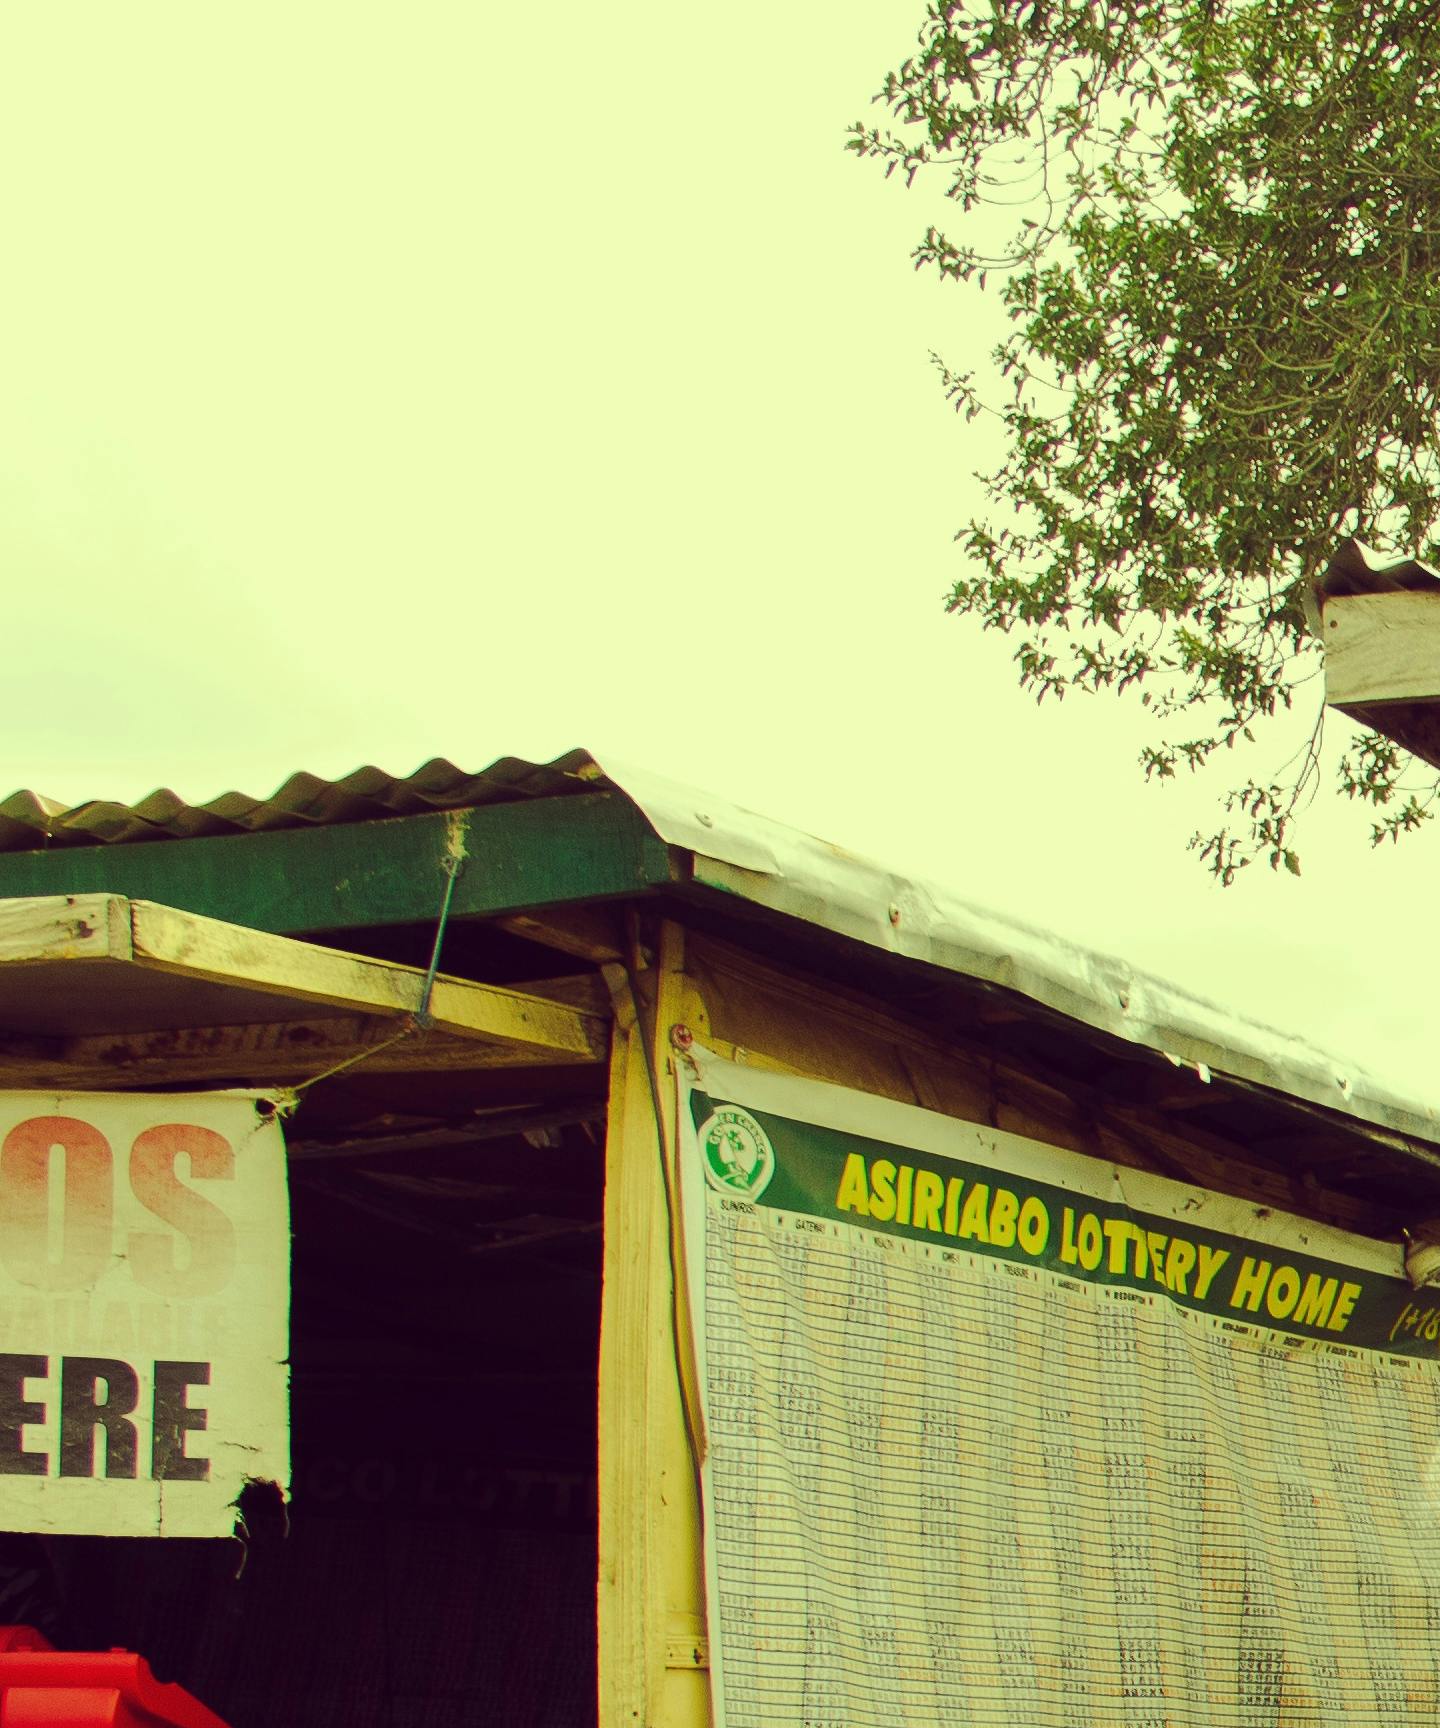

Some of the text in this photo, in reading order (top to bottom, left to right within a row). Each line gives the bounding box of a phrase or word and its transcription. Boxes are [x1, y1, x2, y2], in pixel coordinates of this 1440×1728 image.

[835, 1152, 1363, 1332] ASIRIABO LOTTERY HOME
